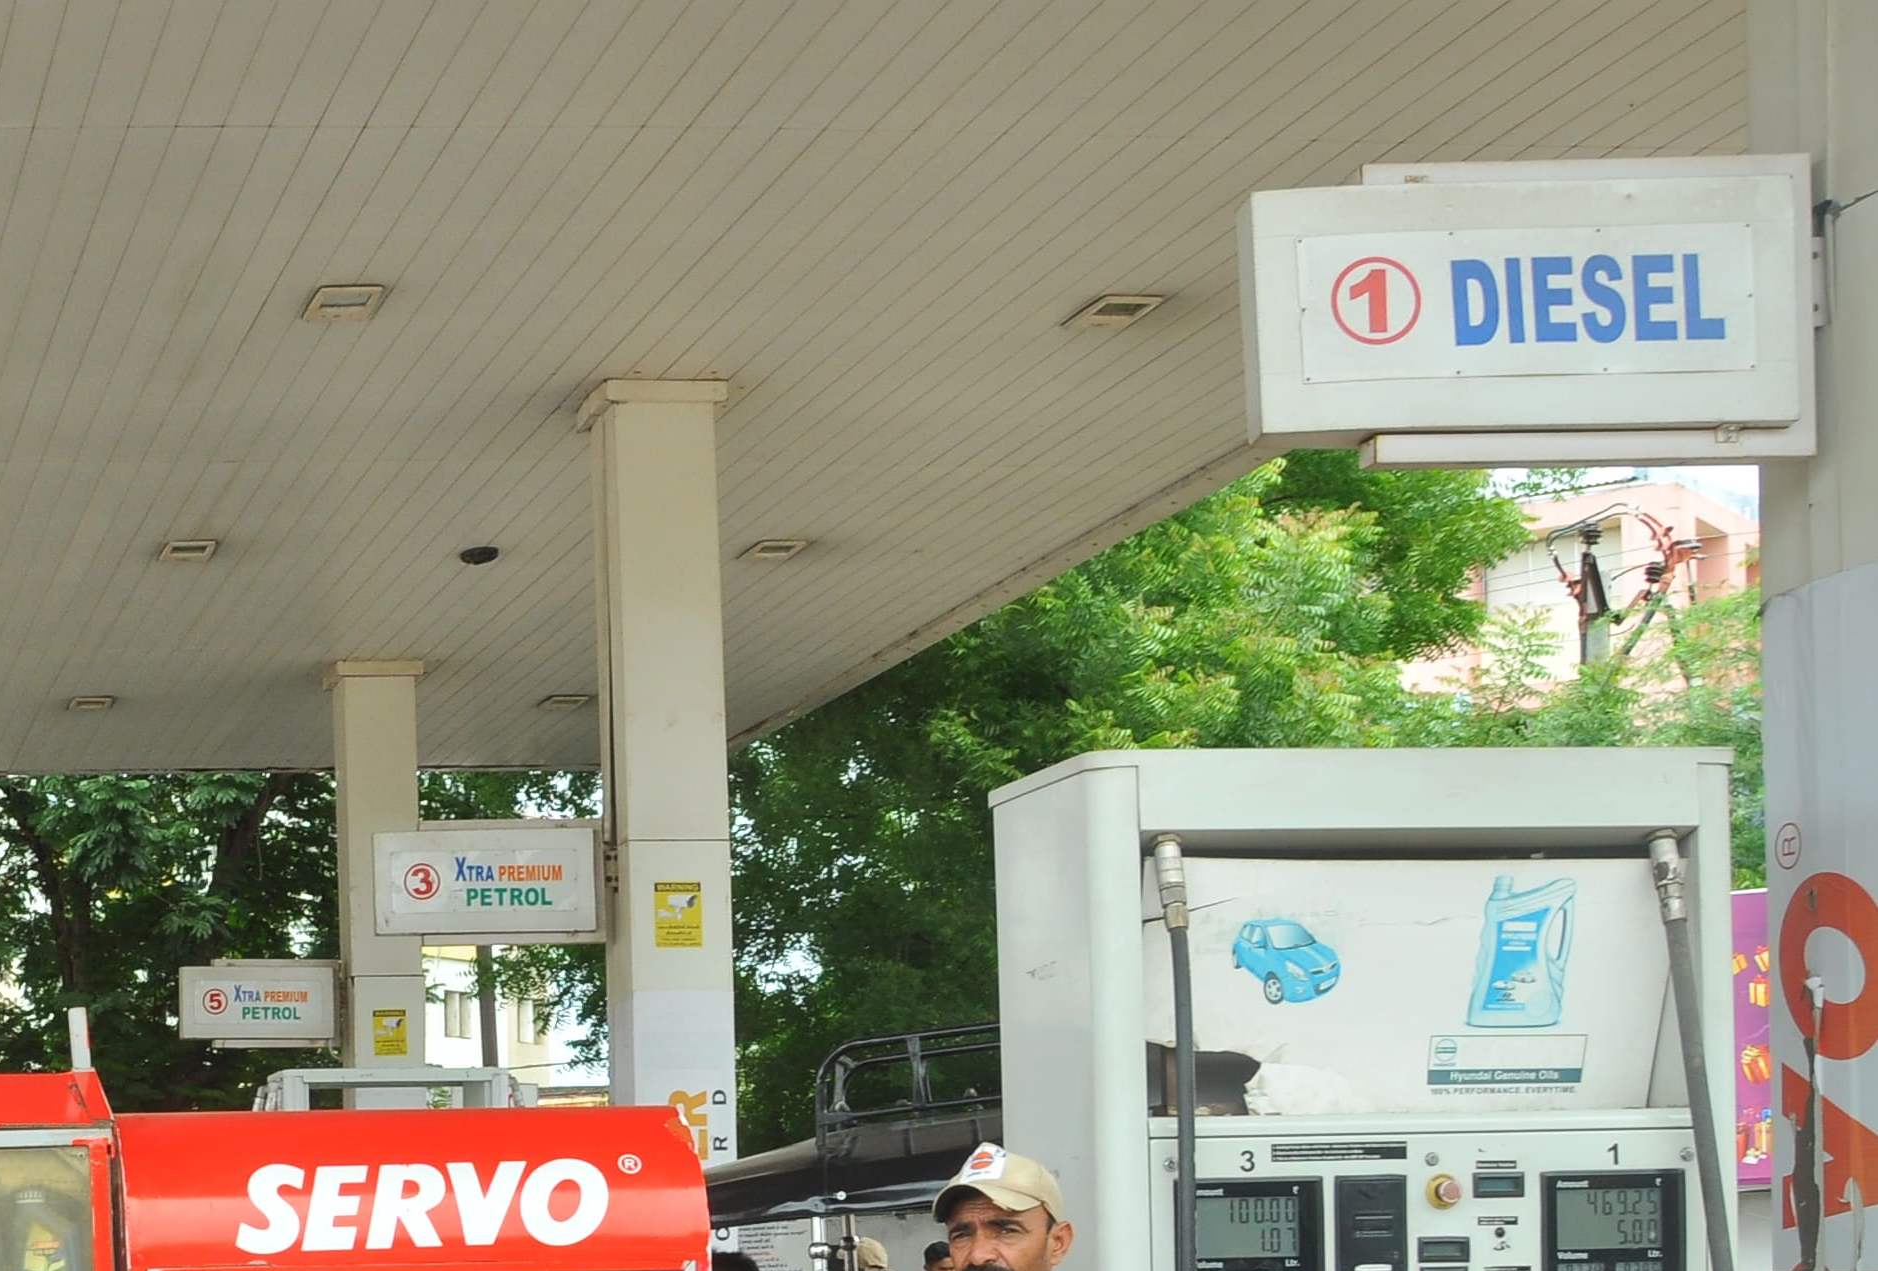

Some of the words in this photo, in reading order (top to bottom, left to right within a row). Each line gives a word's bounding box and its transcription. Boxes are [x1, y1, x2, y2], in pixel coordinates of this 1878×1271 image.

[1449, 252, 1726, 347] DIESEL
[454, 856, 495, 883] XTRA
[498, 863, 563, 883] PREMIUM
[466, 887, 553, 907] PETROL
[233, 985, 262, 1004] XTRA
[264, 990, 309, 1004] PREMIUM
[241, 1006, 302, 1021] PETROL
[1450, 1071, 1491, 1082] Hyundai
[1494, 1070, 1536, 1081] Genuine
[1539, 1069, 1559, 1080] Oils
[1239, 1150, 1256, 1173] 3
[1607, 1143, 1619, 1166] 1
[1196, 1188, 1224, 1196] mount
[1586, 1189, 1659, 1216] 469.25
[234, 1157, 610, 1256] SERVO
[1229, 1199, 1296, 1224] 100.00
[1196, 1260, 1224, 1268] olume
